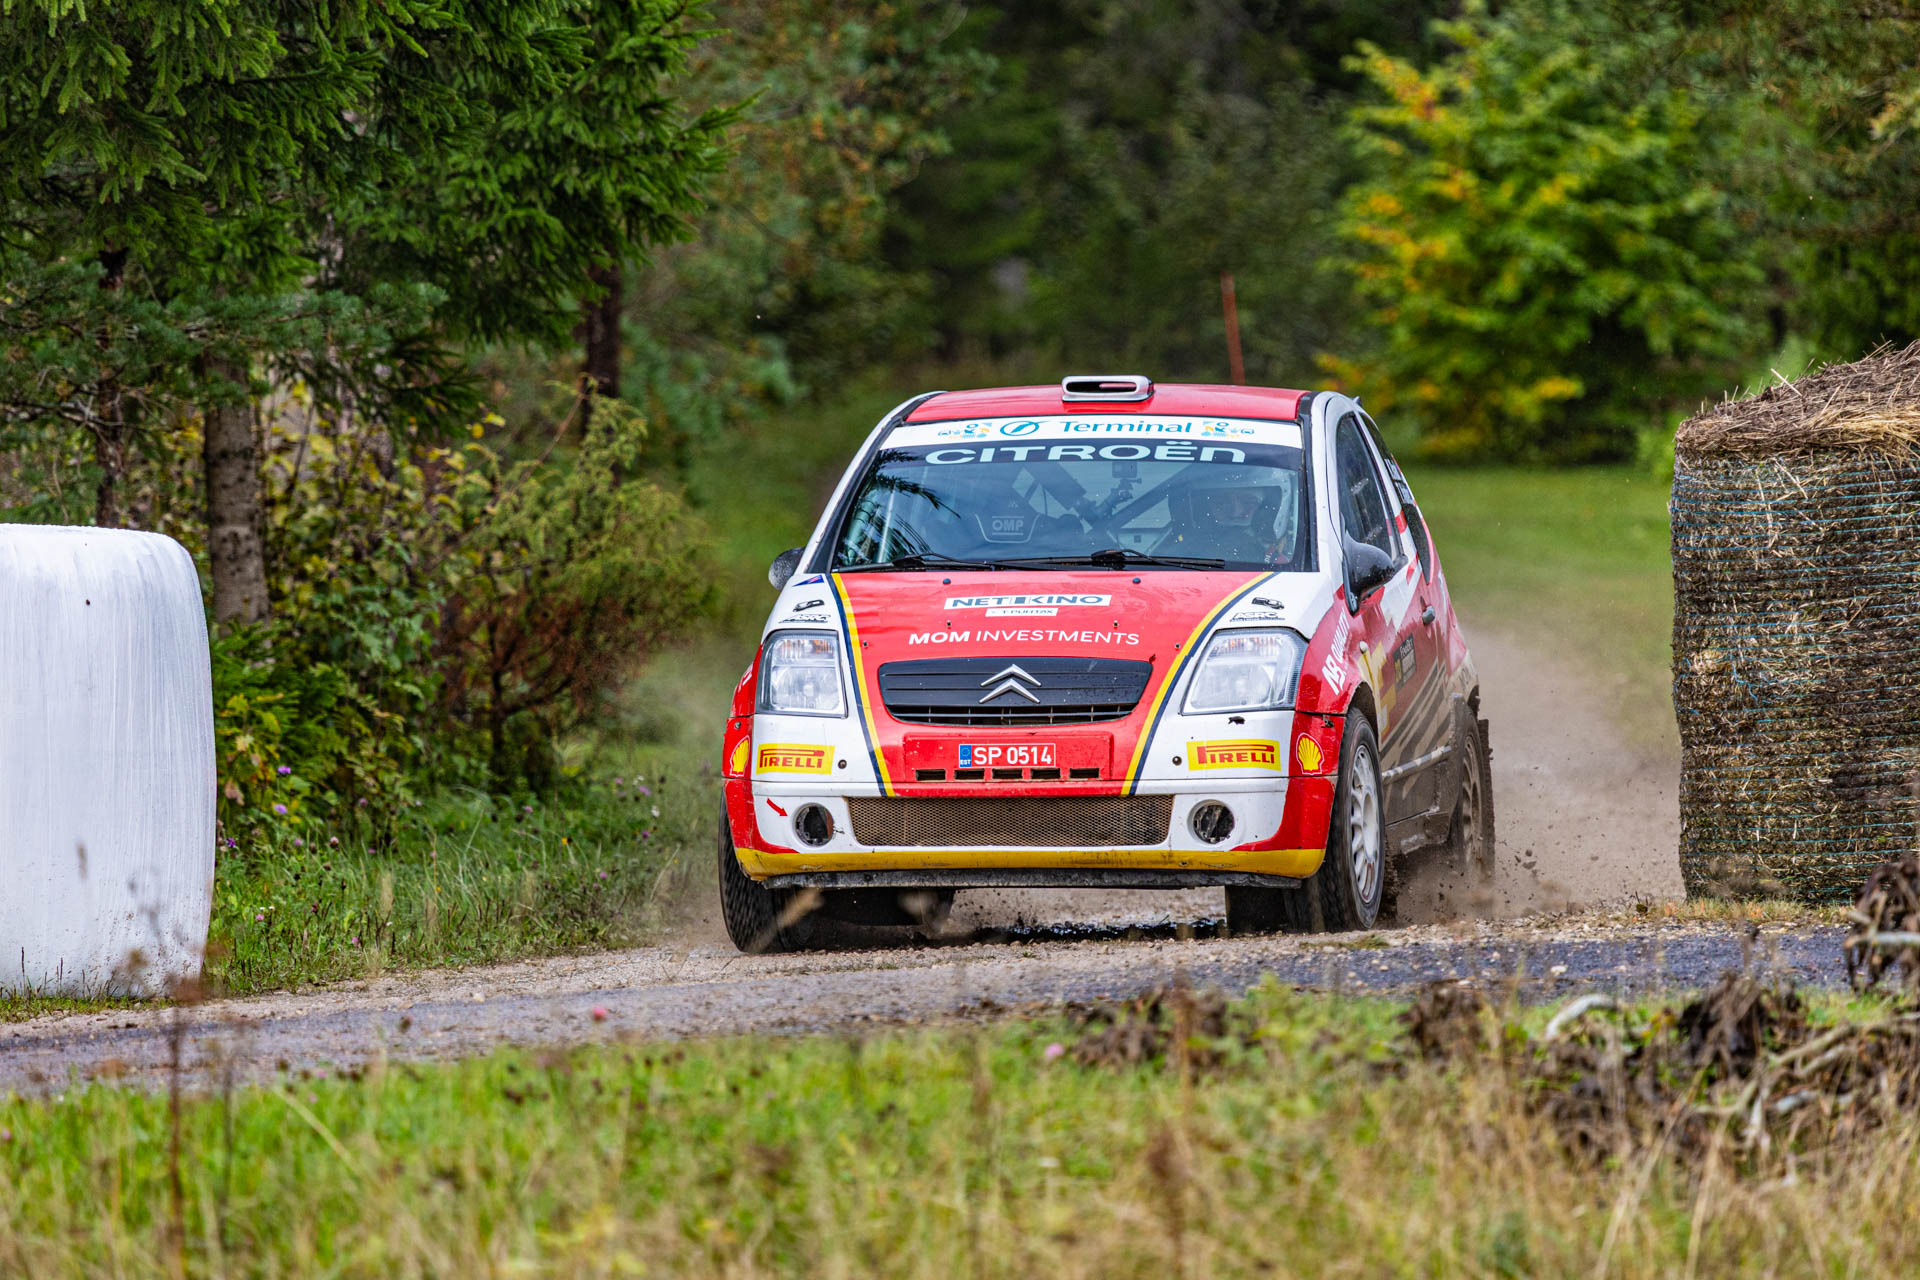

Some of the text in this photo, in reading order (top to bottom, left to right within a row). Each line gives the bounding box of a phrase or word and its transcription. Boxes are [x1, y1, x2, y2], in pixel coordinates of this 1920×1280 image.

[1060, 420, 1191, 434] Terminal
[925, 440, 1246, 465] CITROËN
[992, 519, 1024, 532] OMP
[908, 630, 1140, 645] MOM INVESTMENTS
[759, 748, 825, 769] PIRELLI
[973, 746, 1052, 765] SP 0514
[1196, 744, 1275, 764] PIRELLI
